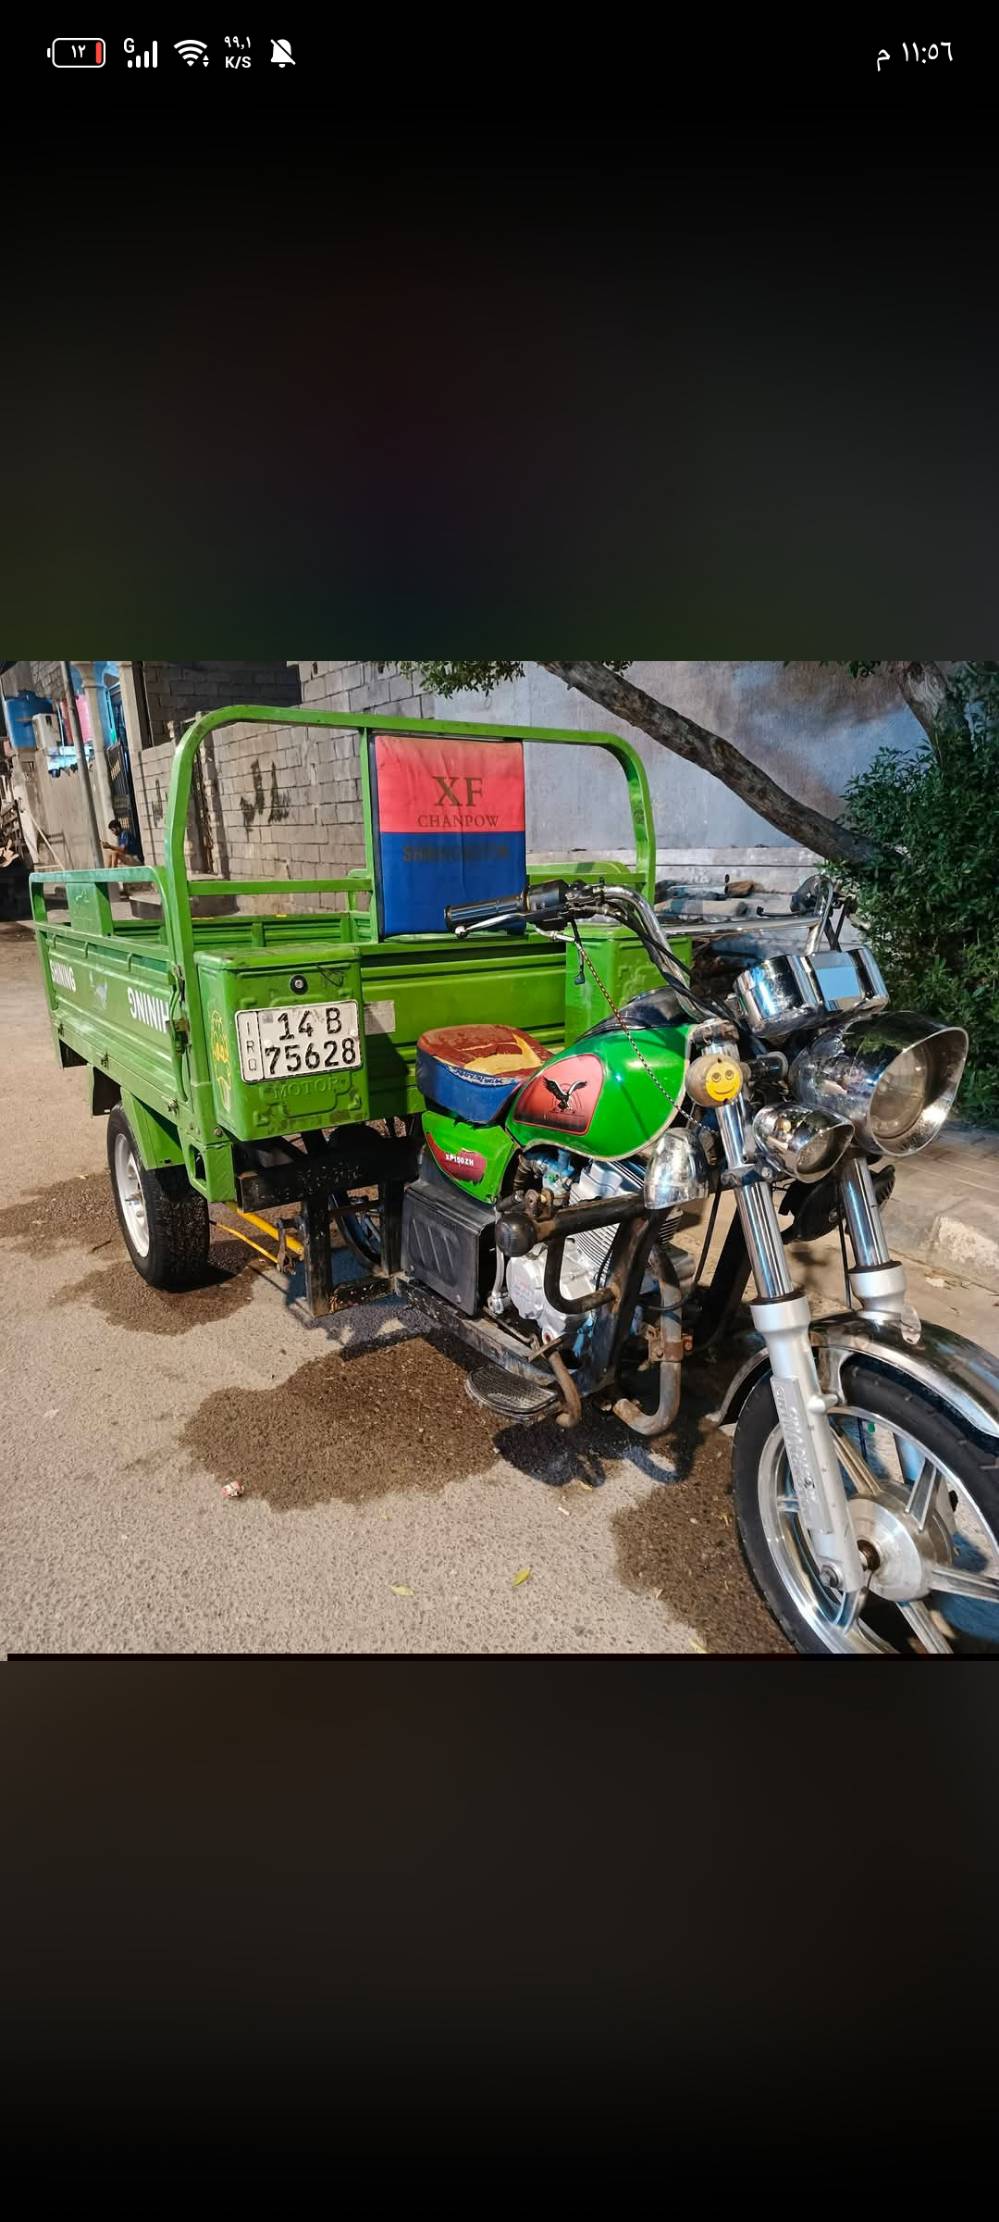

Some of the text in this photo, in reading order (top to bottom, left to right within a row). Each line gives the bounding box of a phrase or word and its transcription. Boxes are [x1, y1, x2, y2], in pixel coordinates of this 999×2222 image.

[432, 775, 484, 807] XF
[417, 813, 499, 829] CHANPOW
[277, 1006, 343, 1041] 14 B
[264, 1036, 357, 1076] 75628
